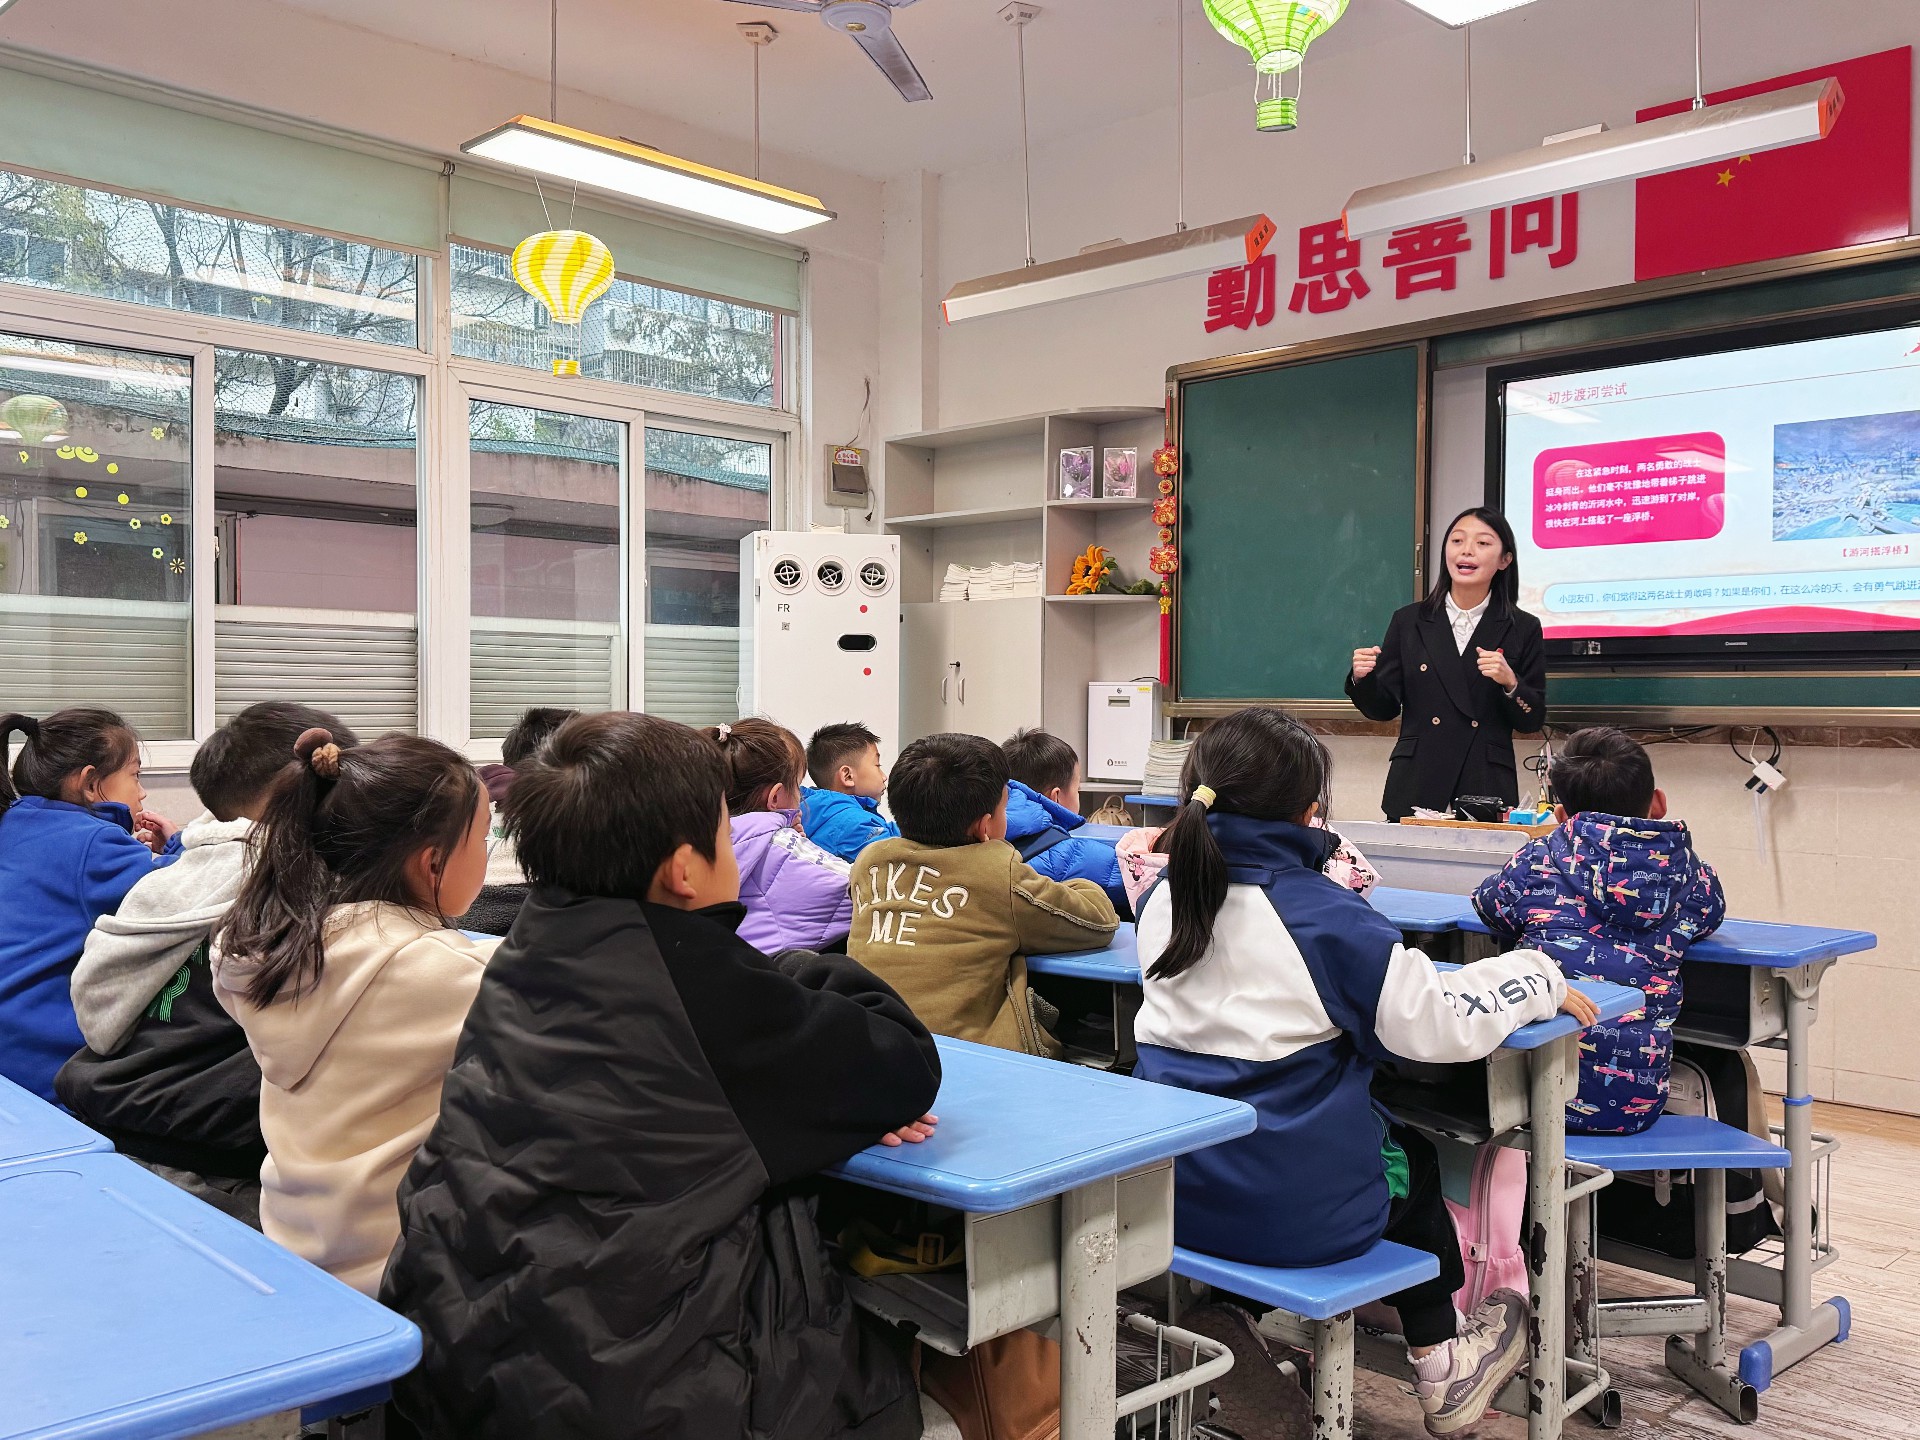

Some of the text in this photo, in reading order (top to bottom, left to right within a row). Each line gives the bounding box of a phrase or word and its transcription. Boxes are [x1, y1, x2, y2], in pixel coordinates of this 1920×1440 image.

[777, 603, 791, 613] FR
[855, 861, 970, 919] LIKES
[866, 910, 922, 947] ME
